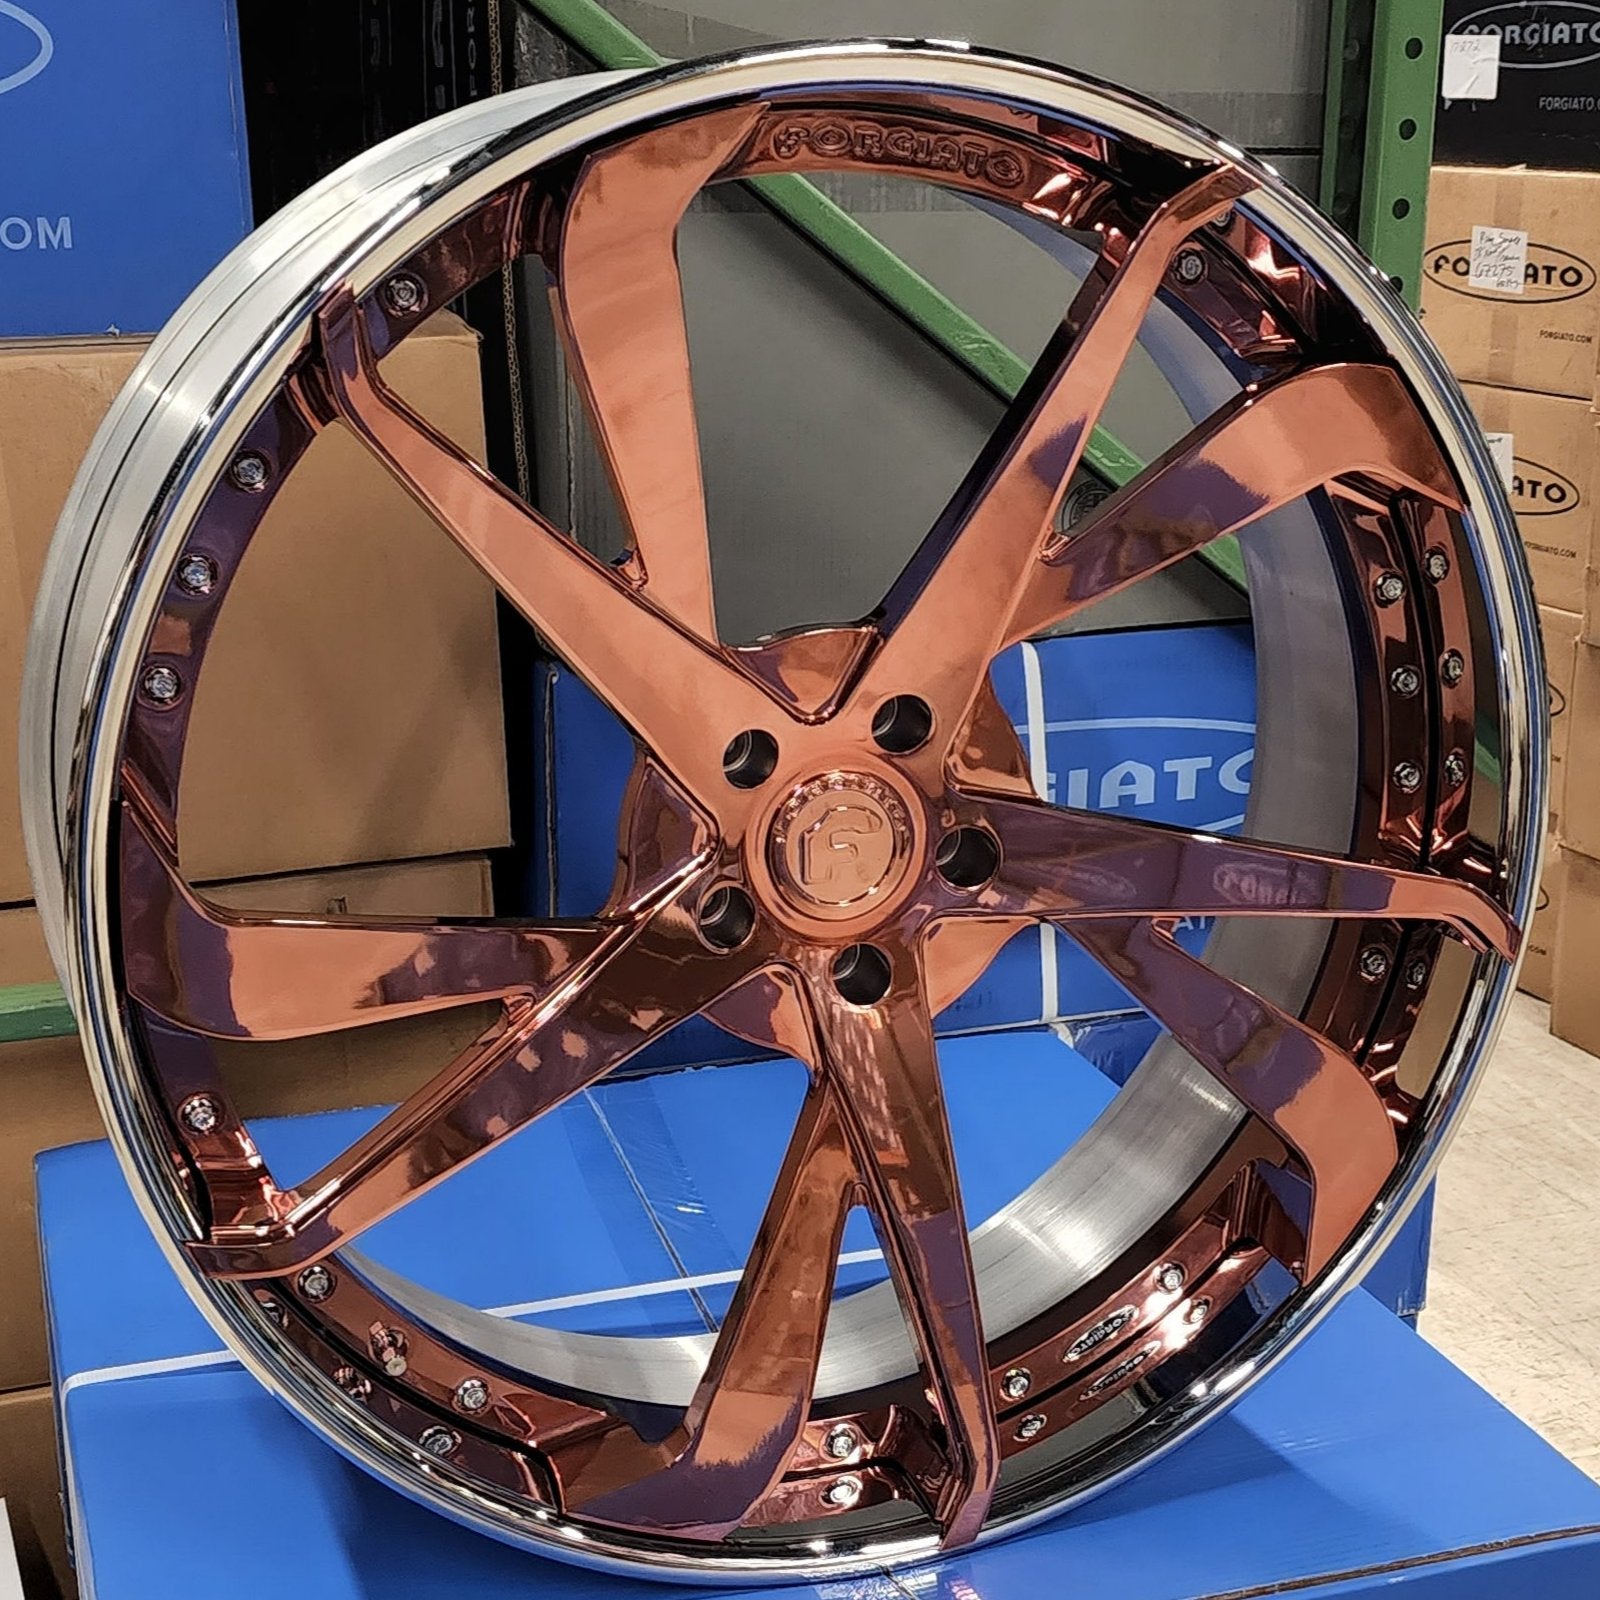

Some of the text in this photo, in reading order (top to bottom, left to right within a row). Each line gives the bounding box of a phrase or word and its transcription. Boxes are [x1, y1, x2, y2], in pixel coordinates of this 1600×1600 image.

[1539, 97, 1600, 111] FORGIATO.
[773, 122, 1026, 187] FORGIATO
[0, 217, 72, 250] OM
